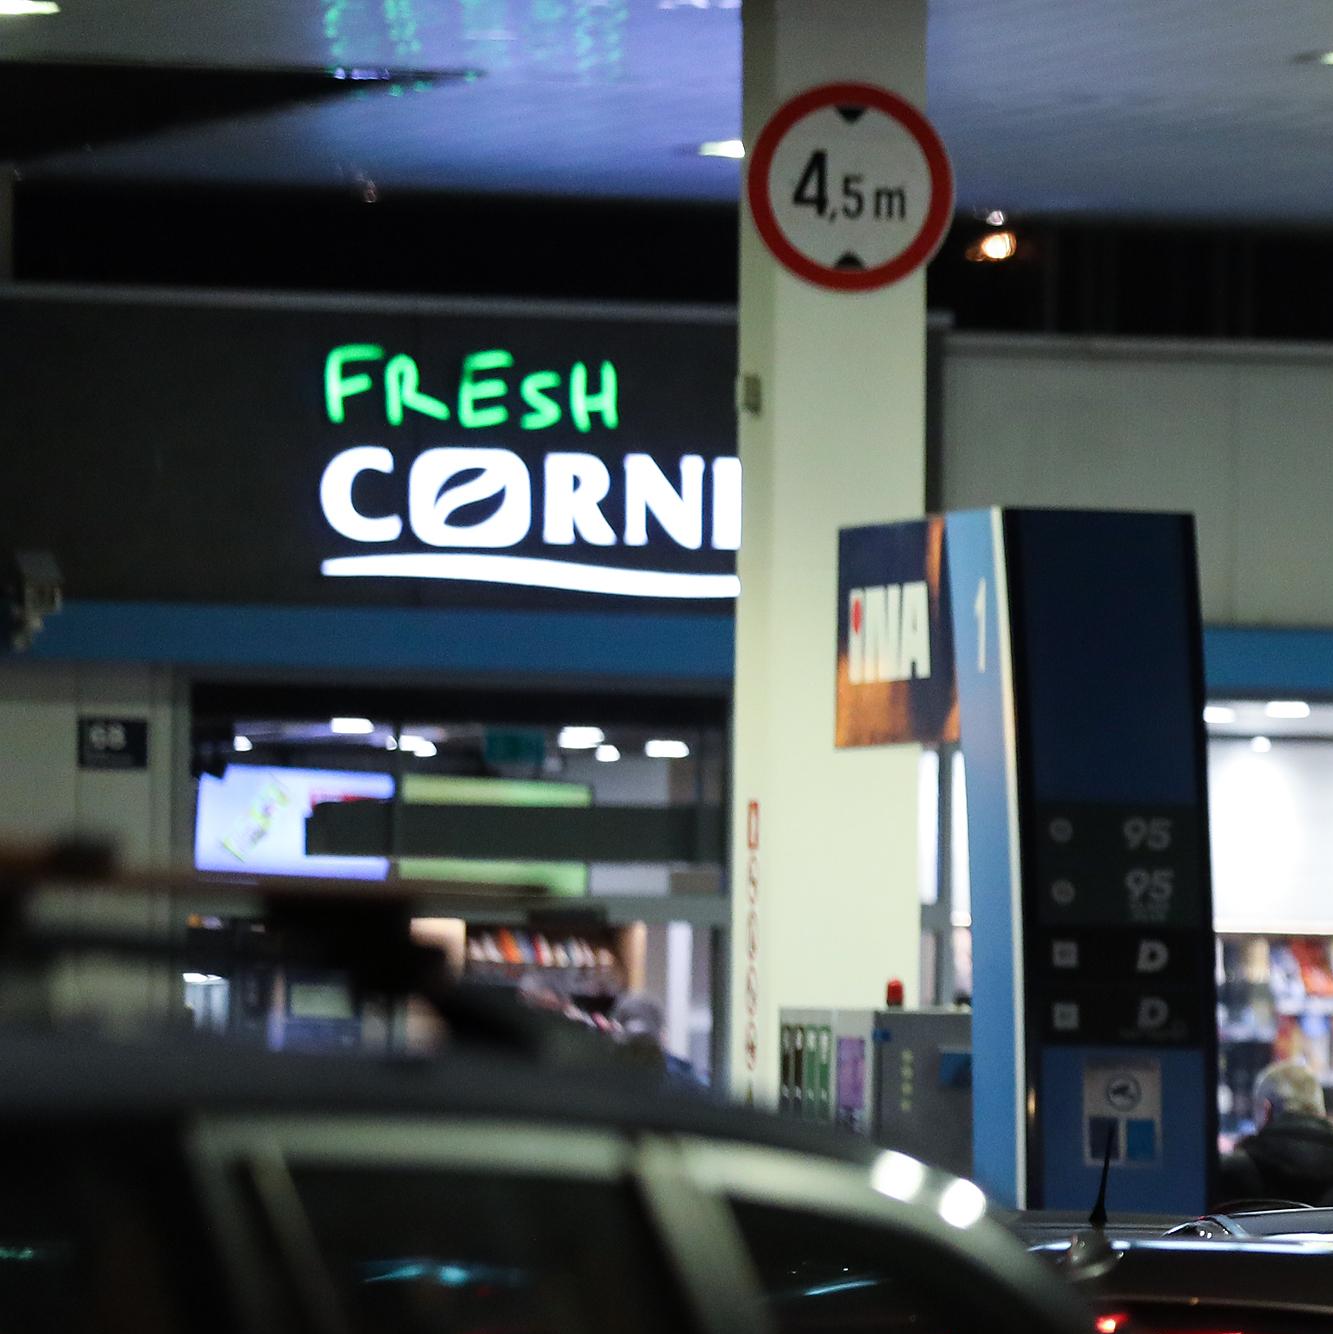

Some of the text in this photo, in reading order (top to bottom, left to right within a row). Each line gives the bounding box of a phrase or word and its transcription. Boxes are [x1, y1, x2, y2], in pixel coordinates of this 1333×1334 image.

[324, 343, 619, 432] FRESH
[974, 576, 987, 674] 1
[1122, 817, 1172, 850] 95
[1137, 939, 1169, 972] D
[1137, 997, 1169, 1028] D
